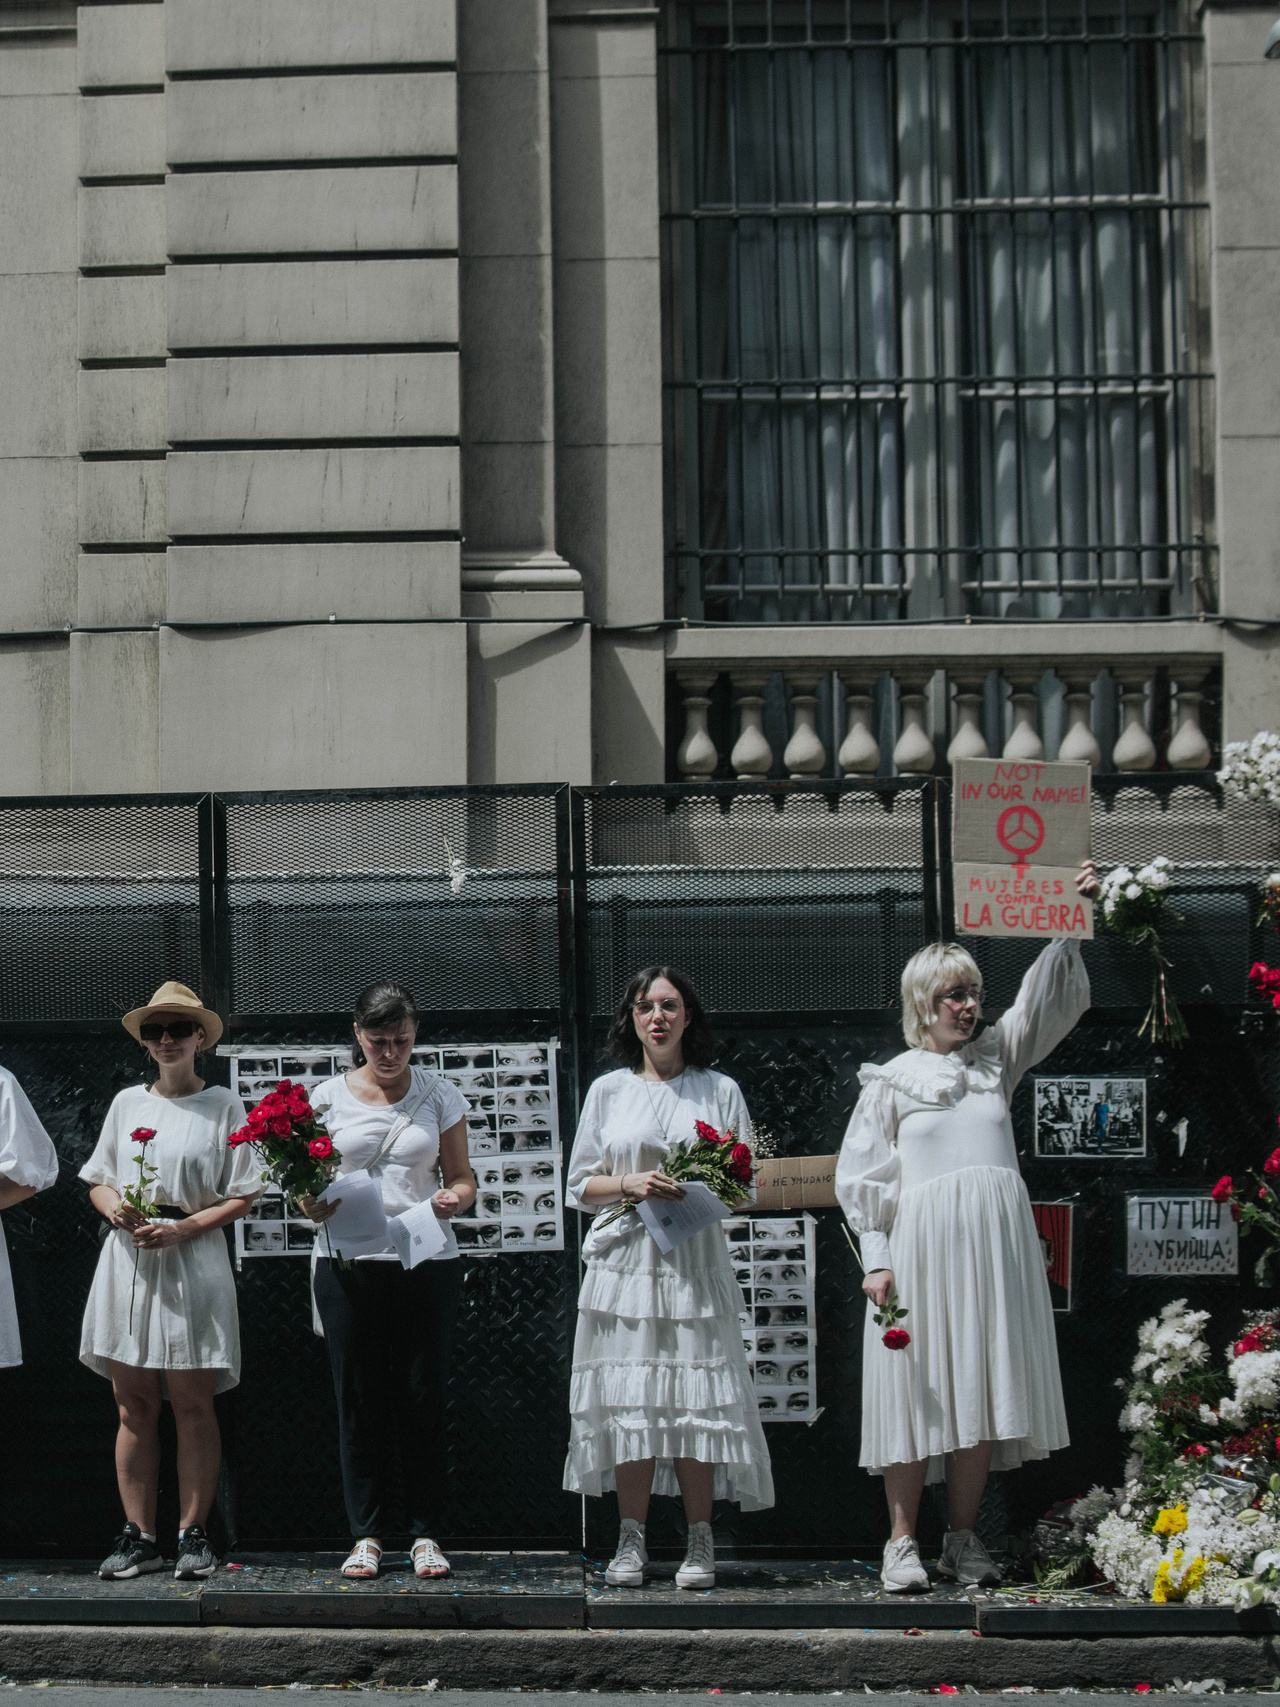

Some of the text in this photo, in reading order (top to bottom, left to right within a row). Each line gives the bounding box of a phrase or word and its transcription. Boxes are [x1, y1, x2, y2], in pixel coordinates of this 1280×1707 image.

[993, 764, 1047, 783] NOT
[961, 782, 1087, 805] IN OUR NAME!
[969, 877, 1065, 895] MUJERES
[995, 894, 1045, 906] CONTRA
[962, 902, 1087, 932] LA GUERRA
[772, 1176, 788, 1188] НЕ
[1138, 1199, 1222, 1231] ПУТИН
[1153, 1237, 1226, 1262] УБИЙЦА
